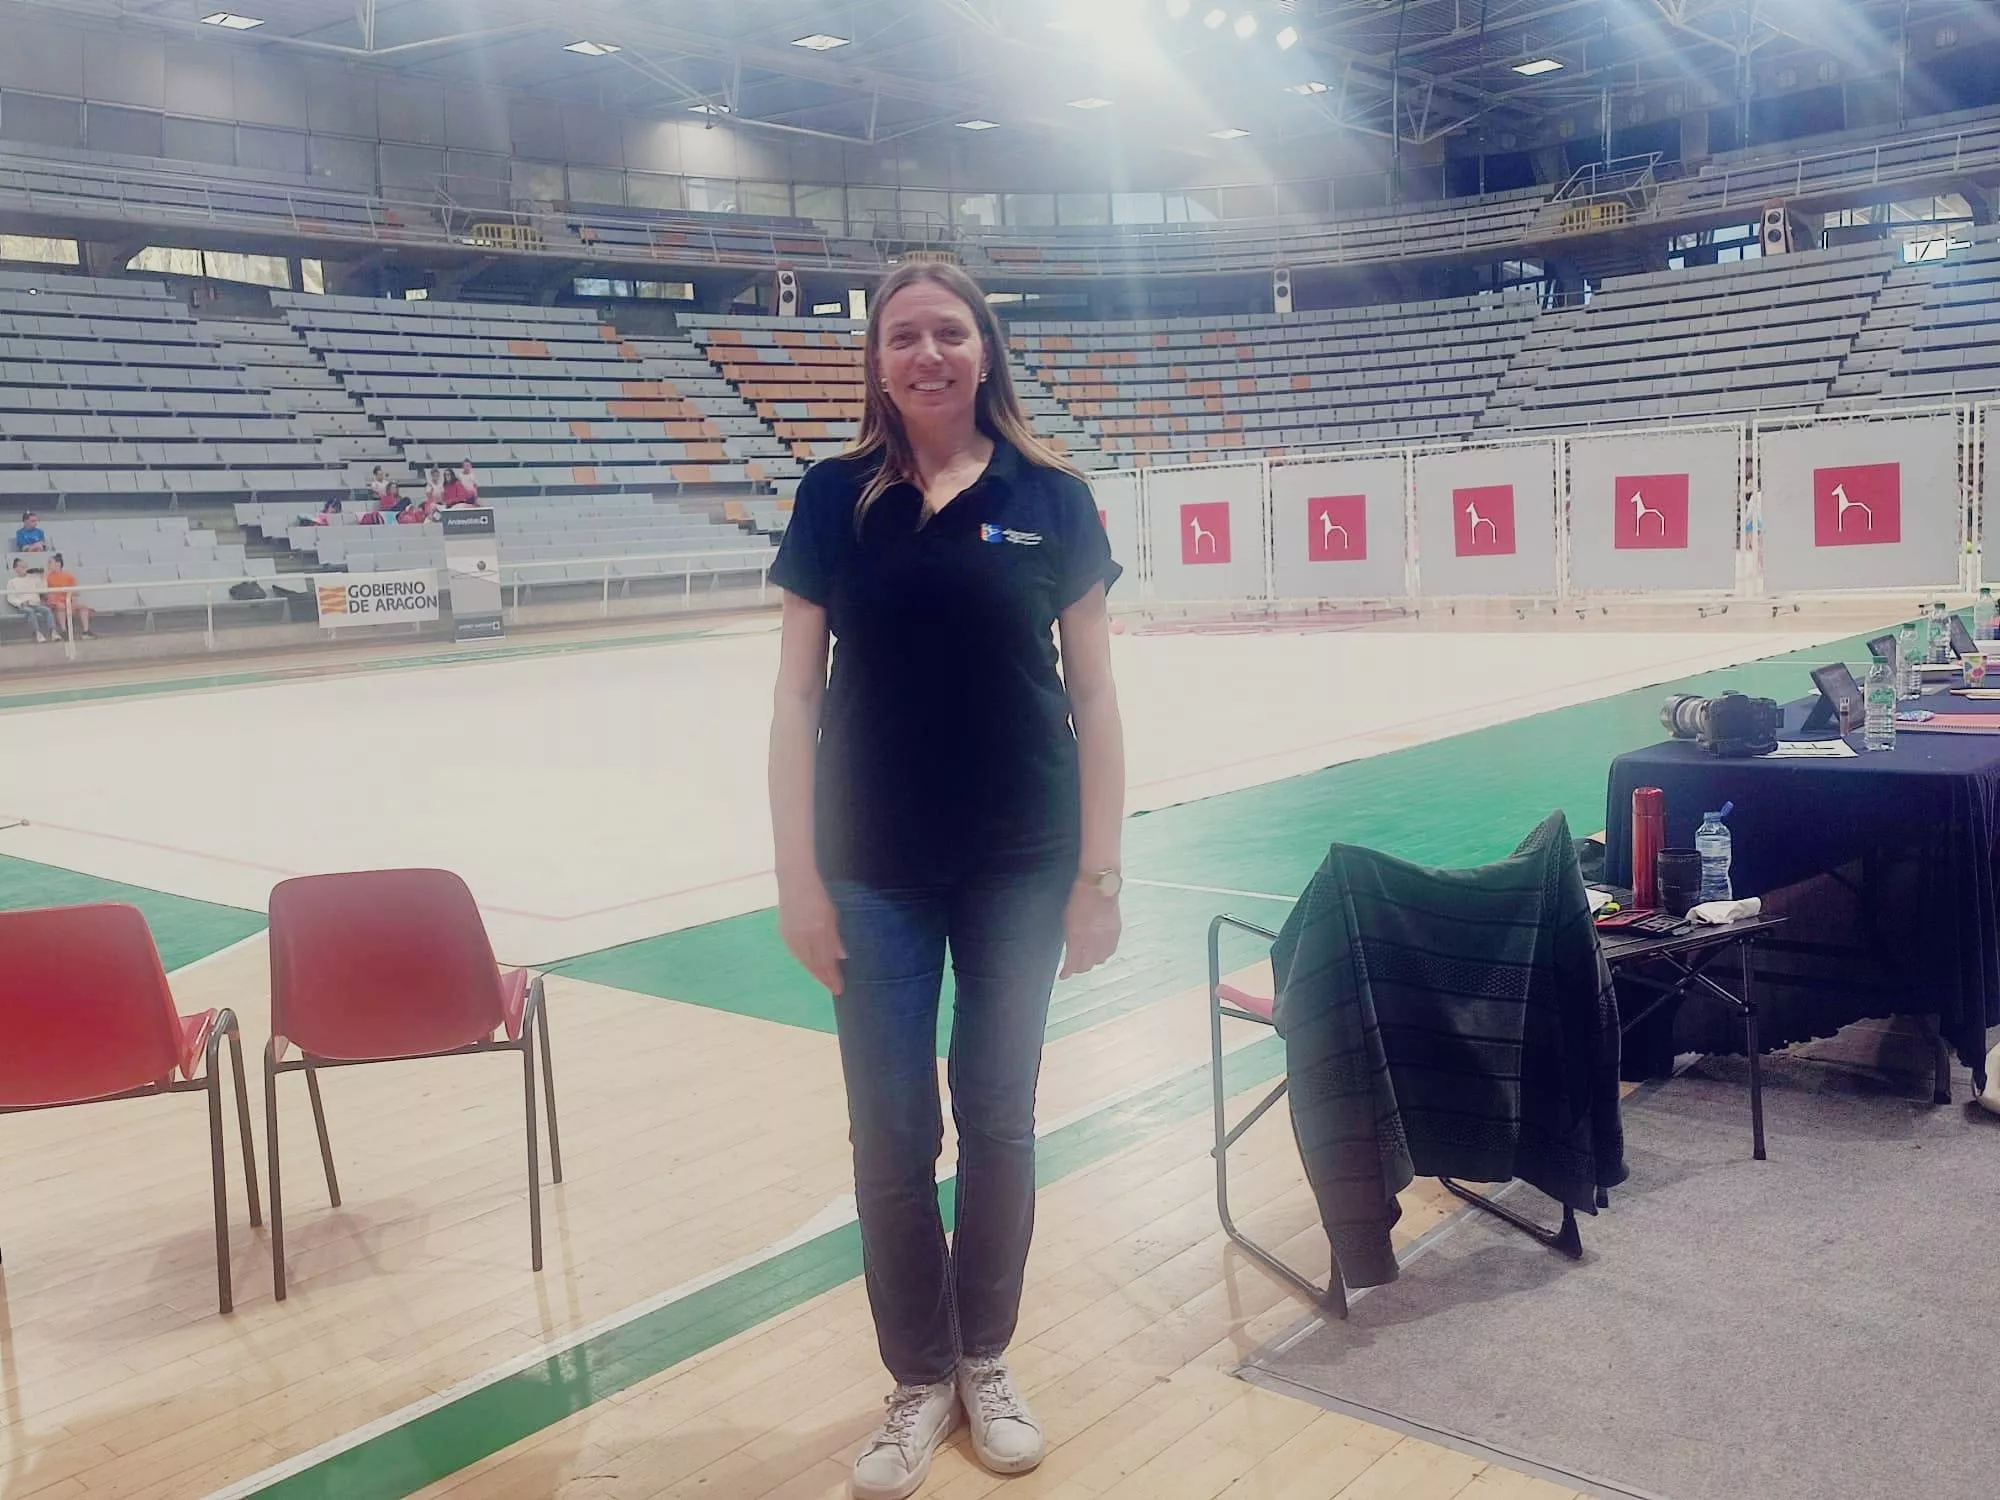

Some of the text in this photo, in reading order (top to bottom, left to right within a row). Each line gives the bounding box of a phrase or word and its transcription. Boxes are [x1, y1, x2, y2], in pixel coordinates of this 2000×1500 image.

[348, 581, 425, 598] GOBIERNO
[349, 596, 437, 613] DE ARAGON
